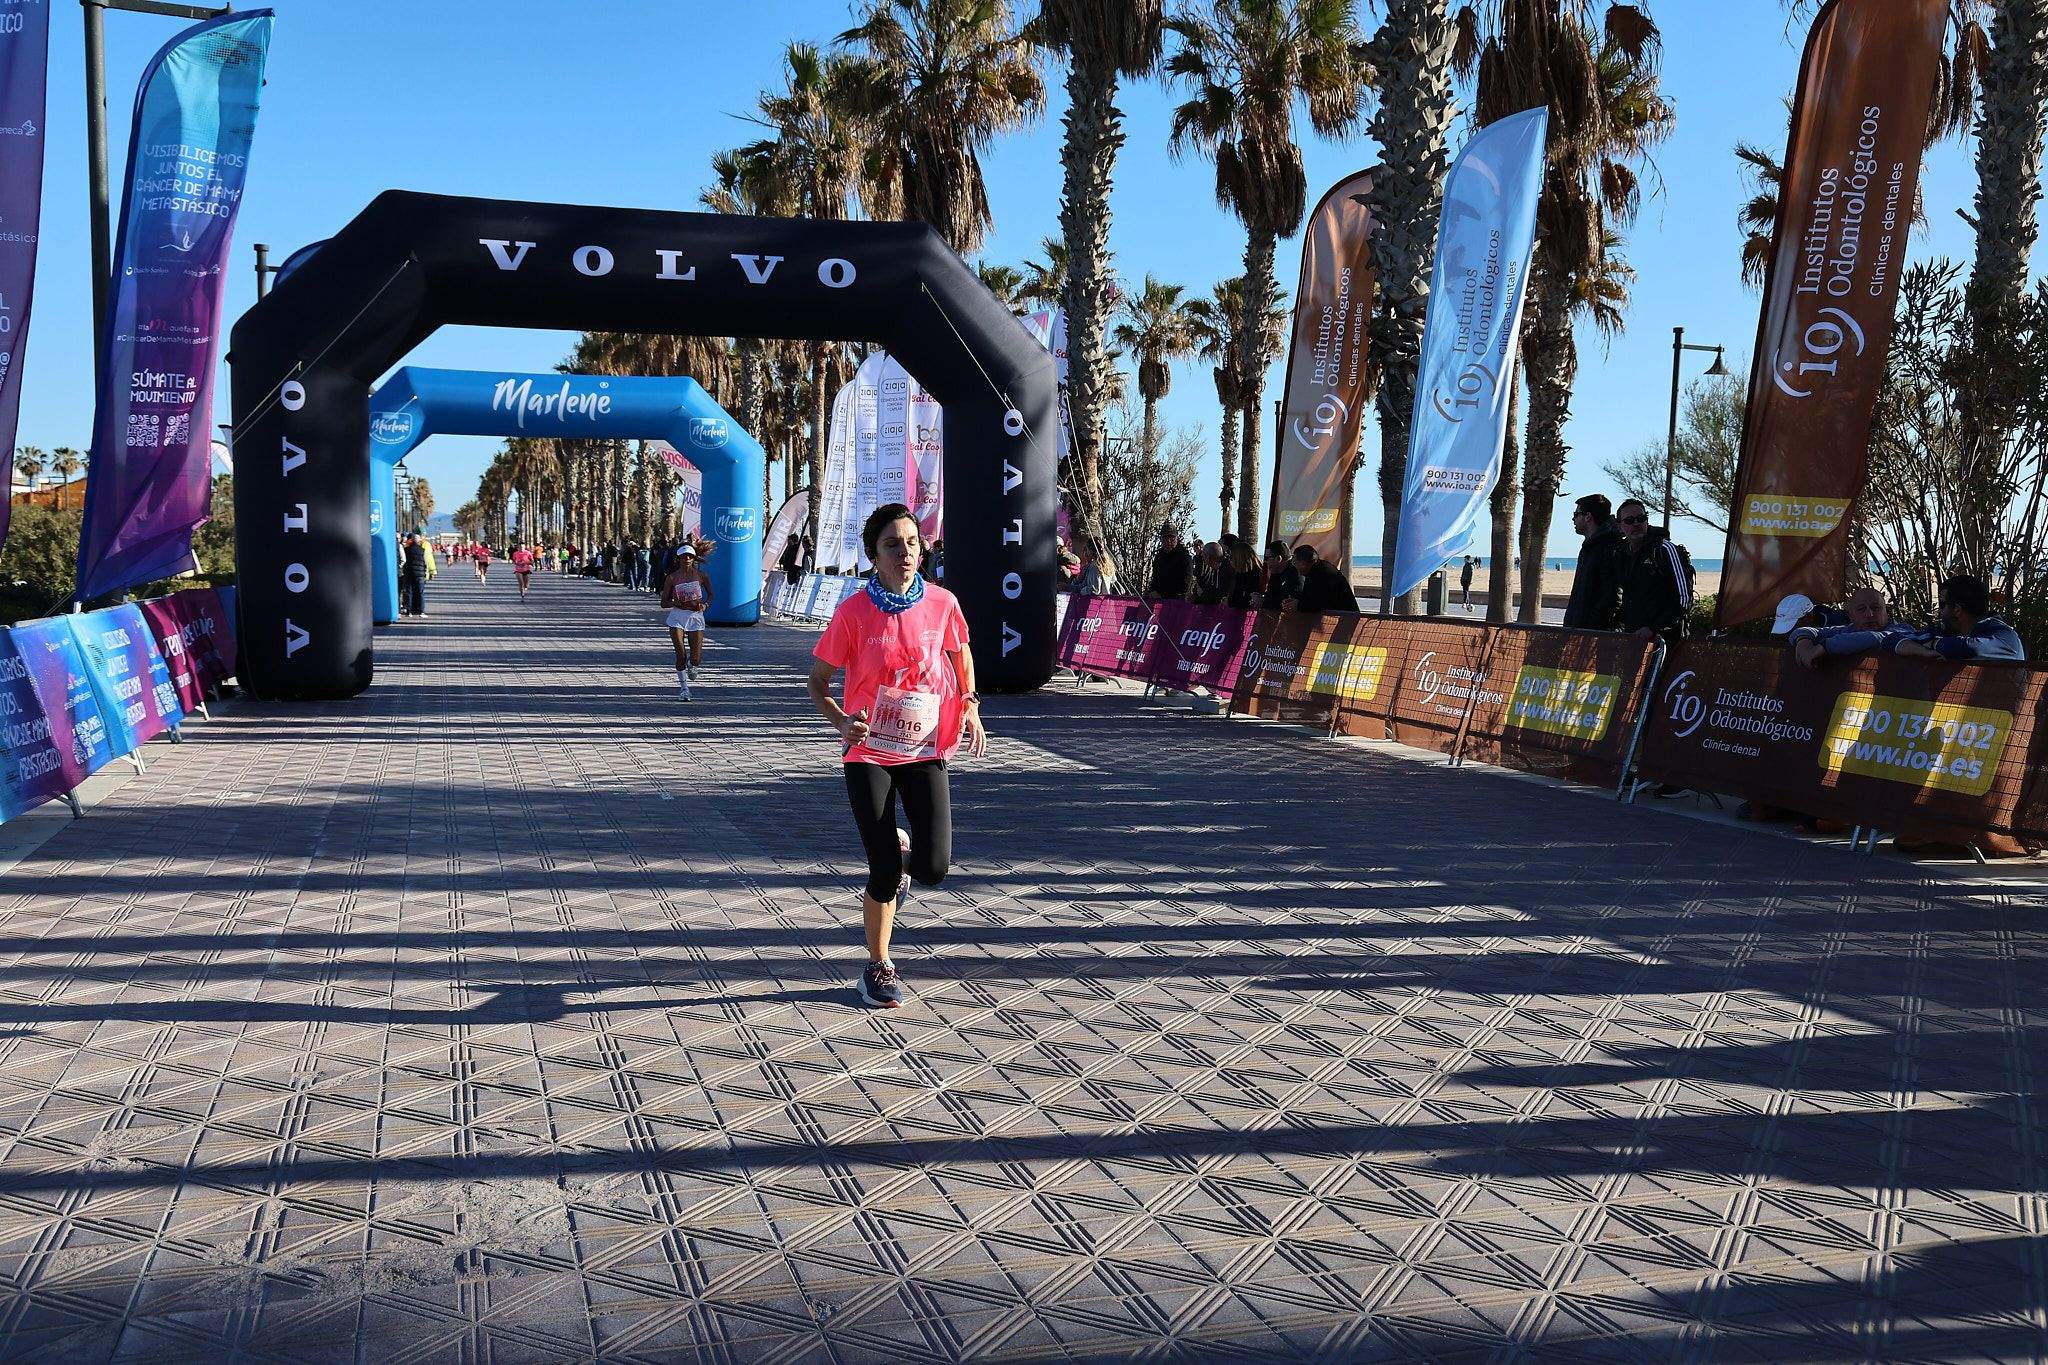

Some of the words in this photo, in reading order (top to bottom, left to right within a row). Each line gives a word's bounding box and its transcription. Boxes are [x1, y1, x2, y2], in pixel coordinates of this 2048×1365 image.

[155, 161, 204, 179] JUNTOS
[207, 169, 223, 181] EL
[184, 180, 202, 196] DE
[142, 197, 230, 218] METASTÁSICO
[1827, 105, 1880, 297] Odontológicos
[1880, 161, 1904, 231] dentales
[1796, 168, 1839, 295] Institutos
[479, 238, 857, 288] VOLVO
[1870, 232, 1894, 297] Clínicas
[1452, 268, 1478, 353] Institutos
[1472, 229, 1501, 357] Odontológicos
[1498, 313, 1511, 357] Clínicas
[1505, 260, 1516, 312] dentales
[1328, 267, 1351, 388] Odontológicos
[1353, 302, 1363, 345] dentales
[1310, 304, 1334, 386] Institutos
[131, 369, 185, 389] SÚMATE
[186, 377, 197, 389] AL
[1349, 346, 1359, 388] Clínicas
[130, 390, 196, 404] MOVIMIENTO
[492, 378, 610, 429] Marlene
[692, 422, 727, 439] Marlene
[1425, 480, 1484, 491] www.ioa.es
[1427, 469, 1448, 479] 900
[1450, 471, 1464, 480] 131
[281, 380, 310, 659] VOLVO
[717, 516, 754, 531] Marlene
[1750, 500, 1782, 514] 900
[1786, 504, 1809, 516] 131
[1813, 504, 1845, 518] 002
[1002, 408, 1024, 658] VOLVO
[1119, 614, 1159, 646] renfe
[1180, 622, 1225, 657] renfe
[1261, 658, 1306, 677] Odontológicos
[1265, 644, 1295, 660] Institutos
[1520, 676, 1551, 697] 900
[1715, 687, 1785, 712] Institutos
[1709, 708, 1813, 742] Odontológicos
[1843, 707, 1891, 734] 900
[1897, 712, 1932, 739] 131
[1939, 719, 1997, 750] 002
[1702, 737, 1731, 754] Clínica
[1731, 741, 1761, 757] dental
[1833, 736, 1984, 779] www.ioa.es
